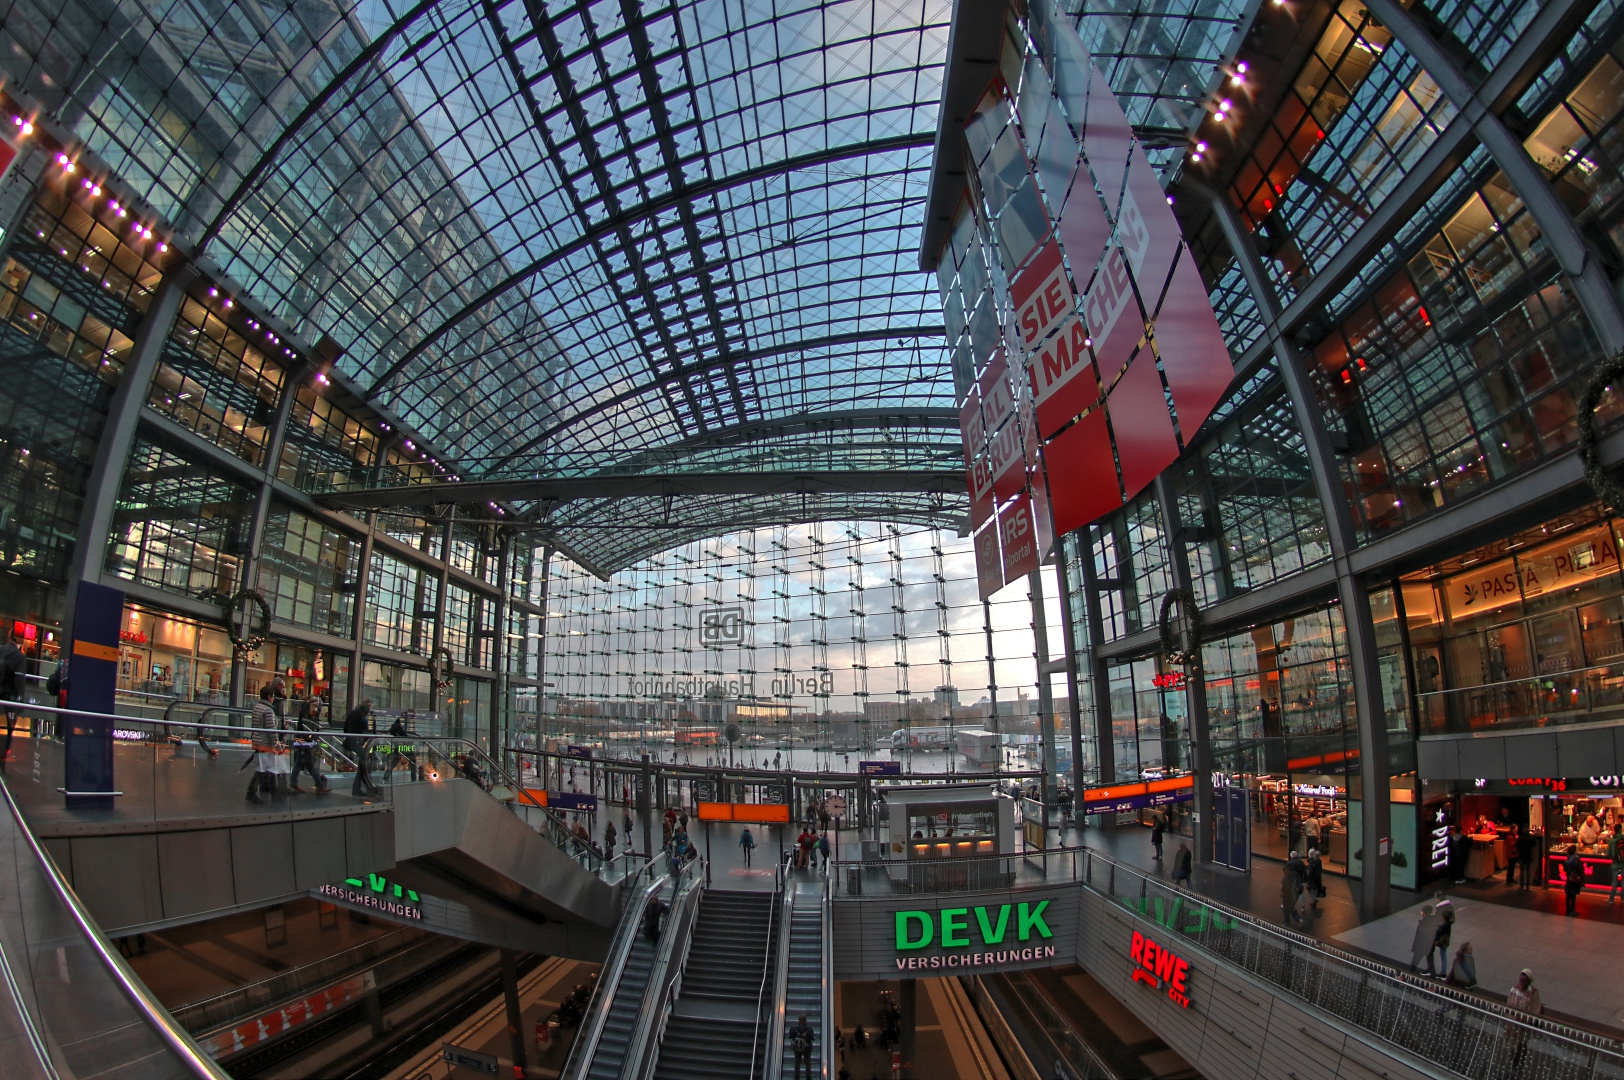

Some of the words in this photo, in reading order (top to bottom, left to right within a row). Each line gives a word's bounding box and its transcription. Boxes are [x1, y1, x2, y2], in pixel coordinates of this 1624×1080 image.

[1022, 277, 1067, 344] SIE
[1431, 825, 1450, 869] PRET
[320, 884, 420, 919] VERSICHERUNGEN
[895, 900, 1053, 950] DEVK
[895, 945, 1055, 970] VERSICHERUNGEN
[1130, 930, 1188, 993] REWE
[1168, 987, 1190, 1009] CITY
